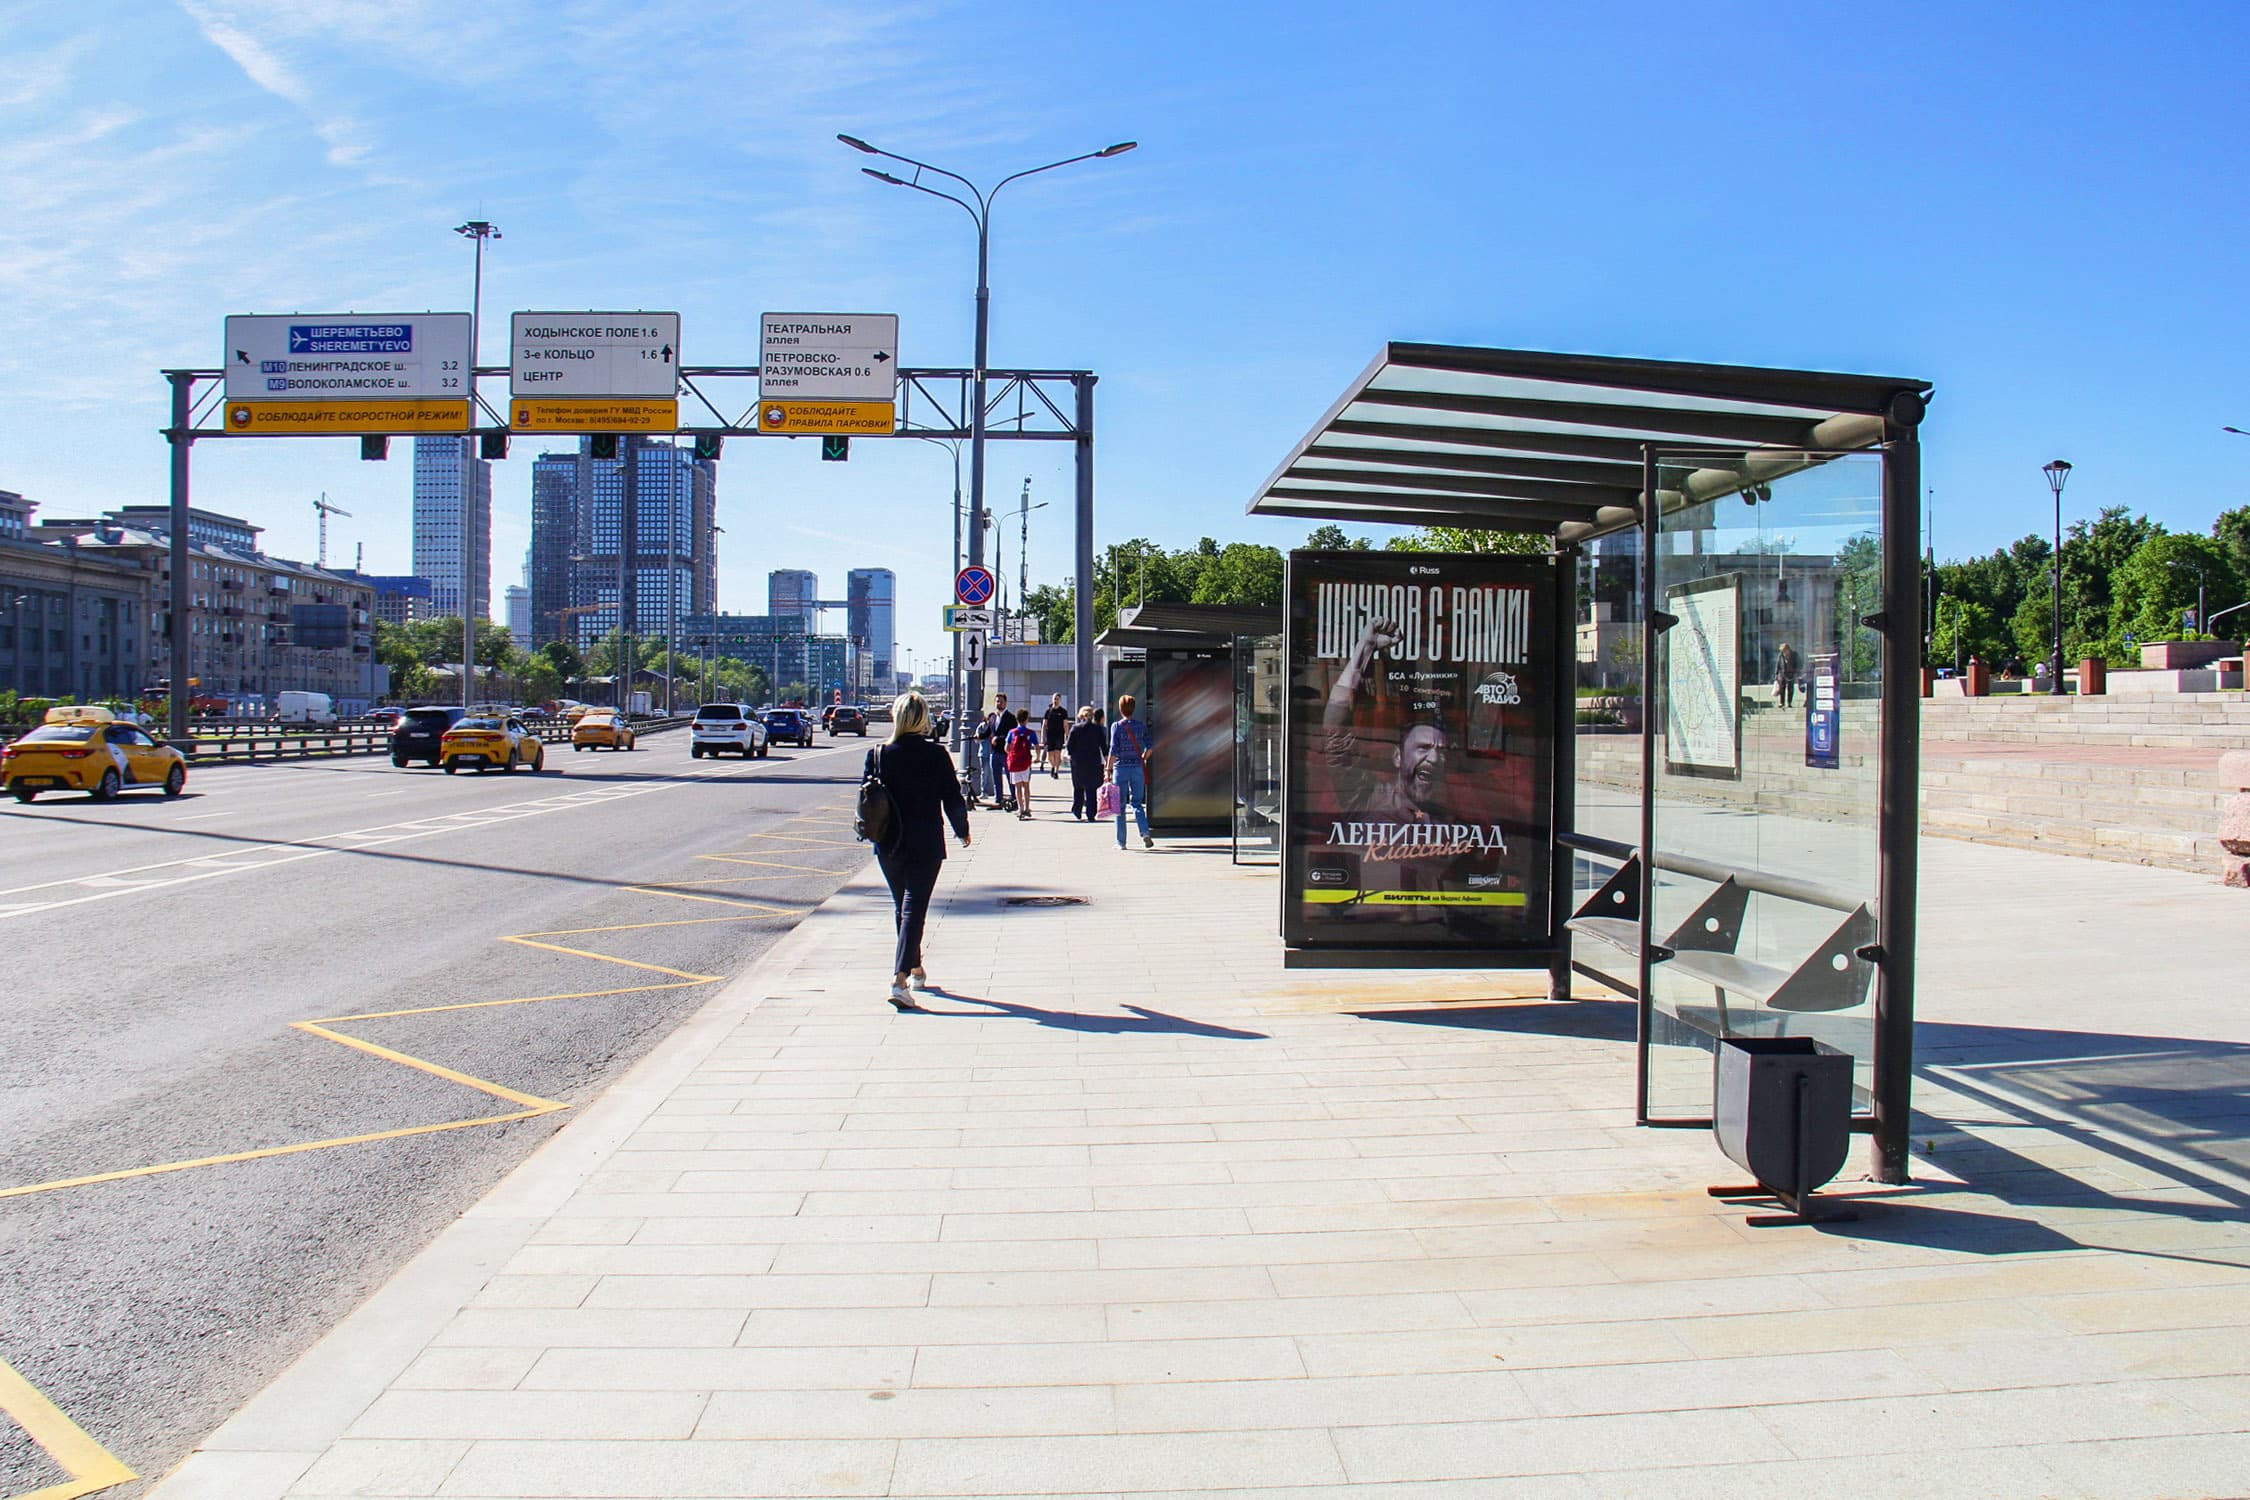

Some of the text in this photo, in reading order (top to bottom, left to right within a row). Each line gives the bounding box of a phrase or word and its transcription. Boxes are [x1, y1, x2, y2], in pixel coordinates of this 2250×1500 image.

[310, 327, 404, 338] ШЕРЕМЕТЬЕВО
[525, 328, 658, 339] ХОДЫНСКОЕ ПОЛЕ 1.6
[766, 324, 851, 334] ТЕАТРАЛЬНАЯ
[766, 337, 800, 345] аллея
[523, 350, 658, 361] 3-е КОЛЬЦО 1.6
[765, 353, 841, 363] ПЕТРОВСКО-
[263, 361, 458, 373] М10 ЛЕНИНГРАДСКОЕ ш. 3.2
[765, 367, 871, 377] РАЗУМОВСКАЯ 0.6
[523, 372, 563, 383] ЦЕНТР
[288, 378, 395, 389] ВОЛОКОЛАМСКОЕ
[442, 378, 458, 387] 3.2
[256, 410, 463, 423] СОБЛЮДАЙТЕ СКОРОСТНОЙ РЕЖИМ!
[789, 407, 857, 416] СОБЛЮДАЙТЕ
[788, 419, 890, 429] ПРАВИЛА ПАРКОВКИ!
[1419, 566, 1440, 575] Russ
[1317, 583, 1530, 664] ШНУРОВ С ВАМИ!
[1388, 671, 1406, 680] БСА
[1474, 684, 1505, 694] АВТО
[1482, 694, 1521, 705] РАДИО
[1326, 822, 1507, 855] ЛЕНИНГРАД
[1363, 838, 1473, 863] Классика
